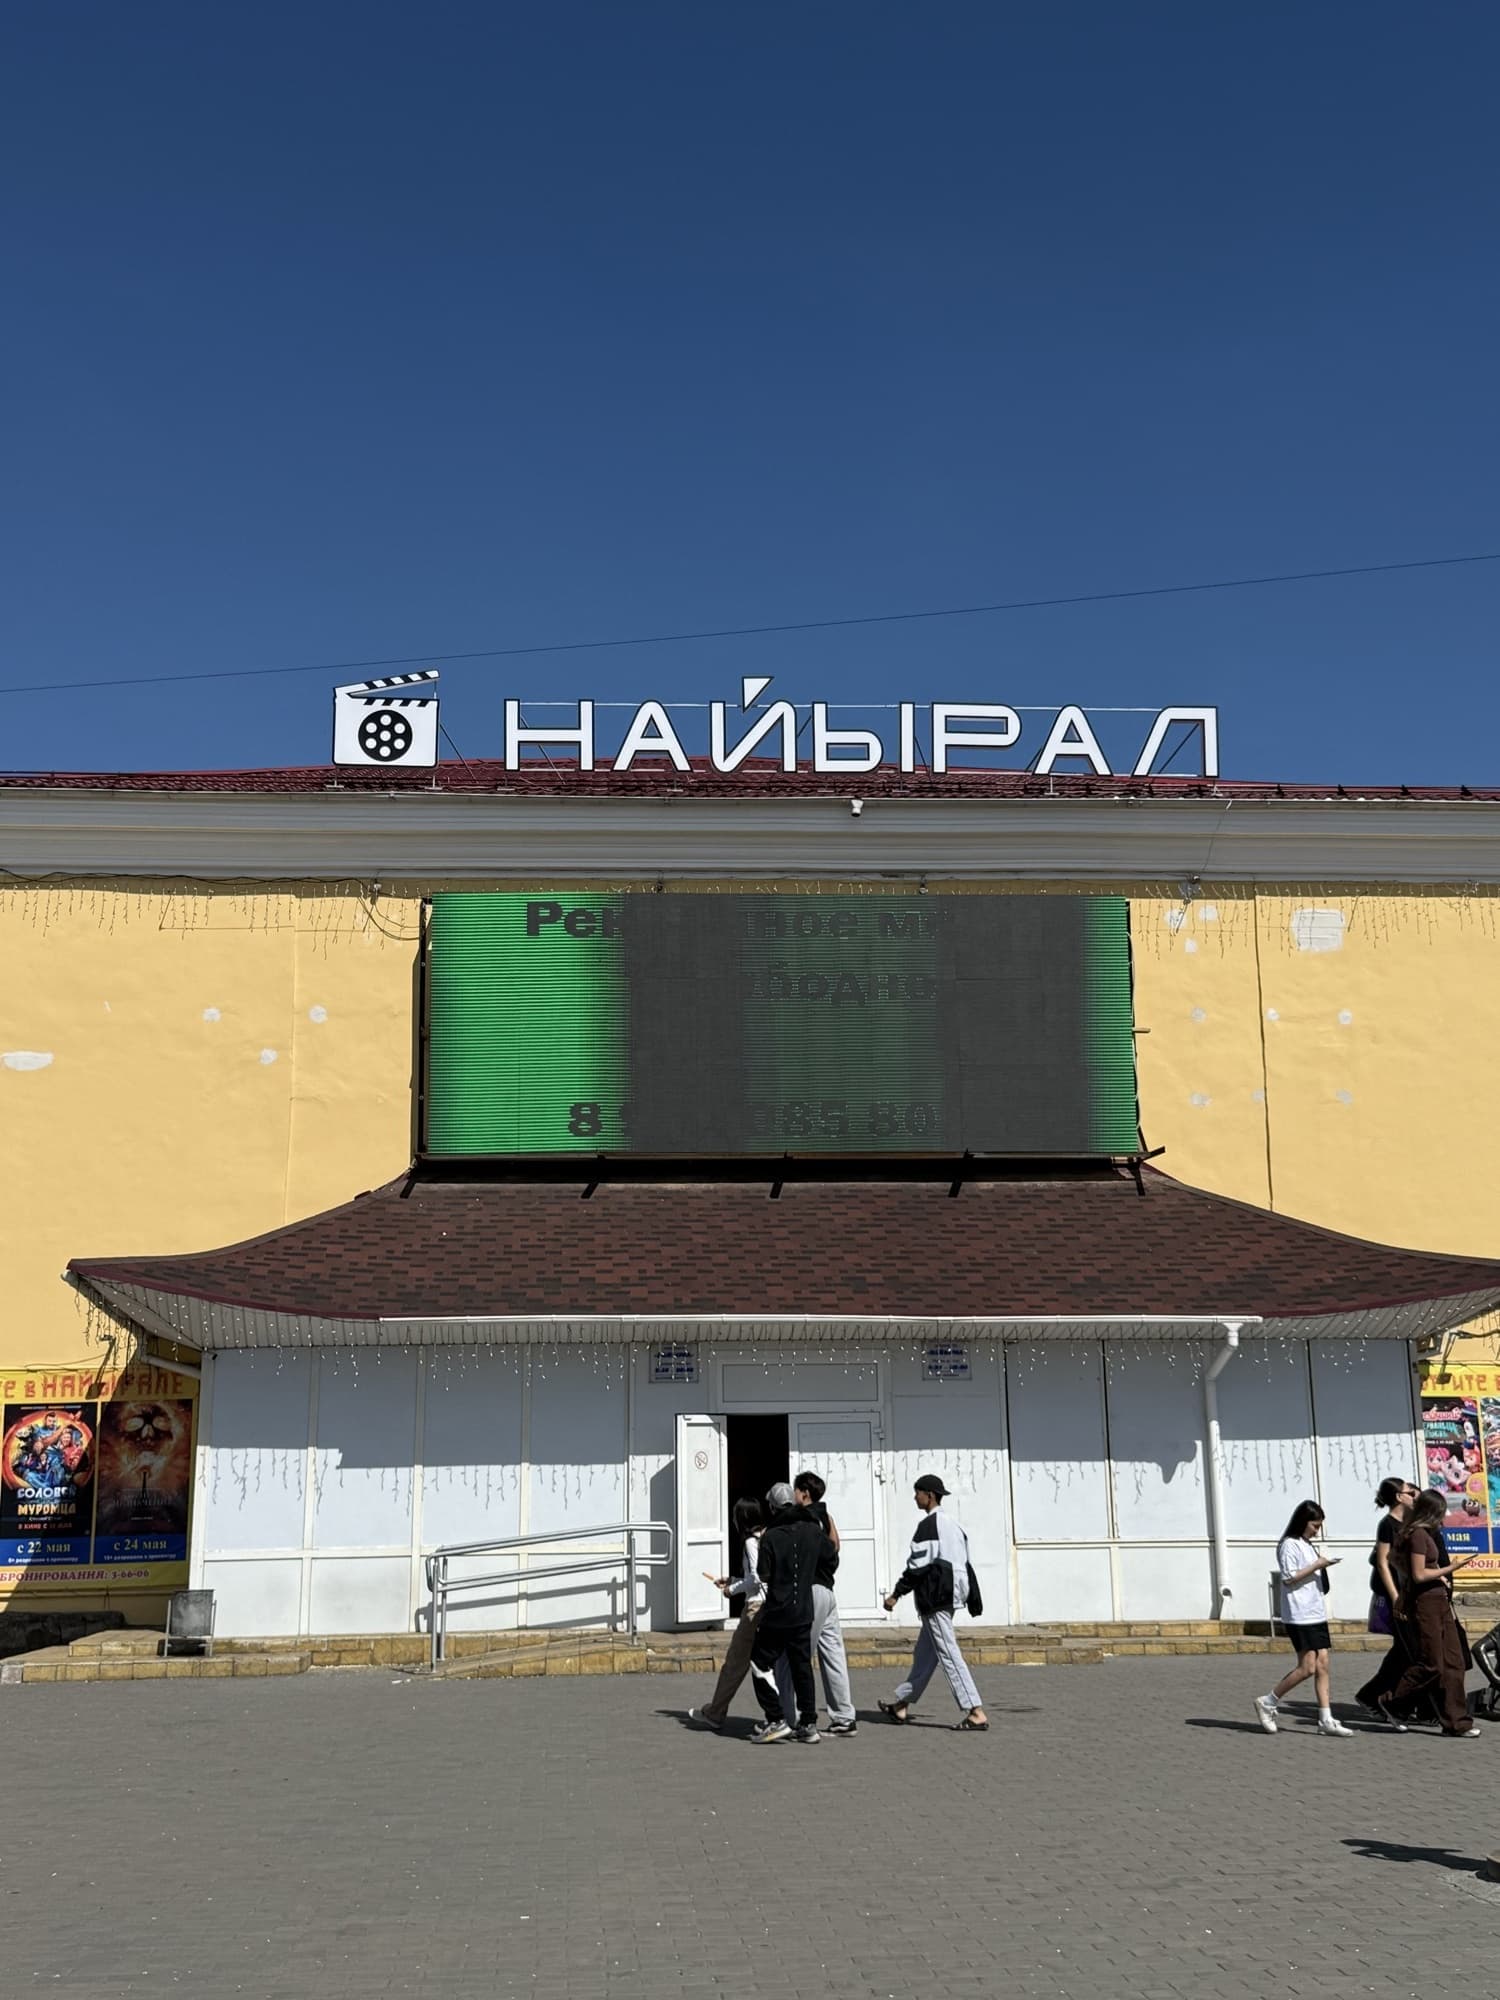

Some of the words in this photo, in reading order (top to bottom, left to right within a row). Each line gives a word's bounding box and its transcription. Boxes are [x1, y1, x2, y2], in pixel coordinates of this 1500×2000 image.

[503, 676, 1220, 779] НАЙЫРАЛ
[27, 1541, 42, 1553] 22
[124, 1538, 138, 1551] 24
